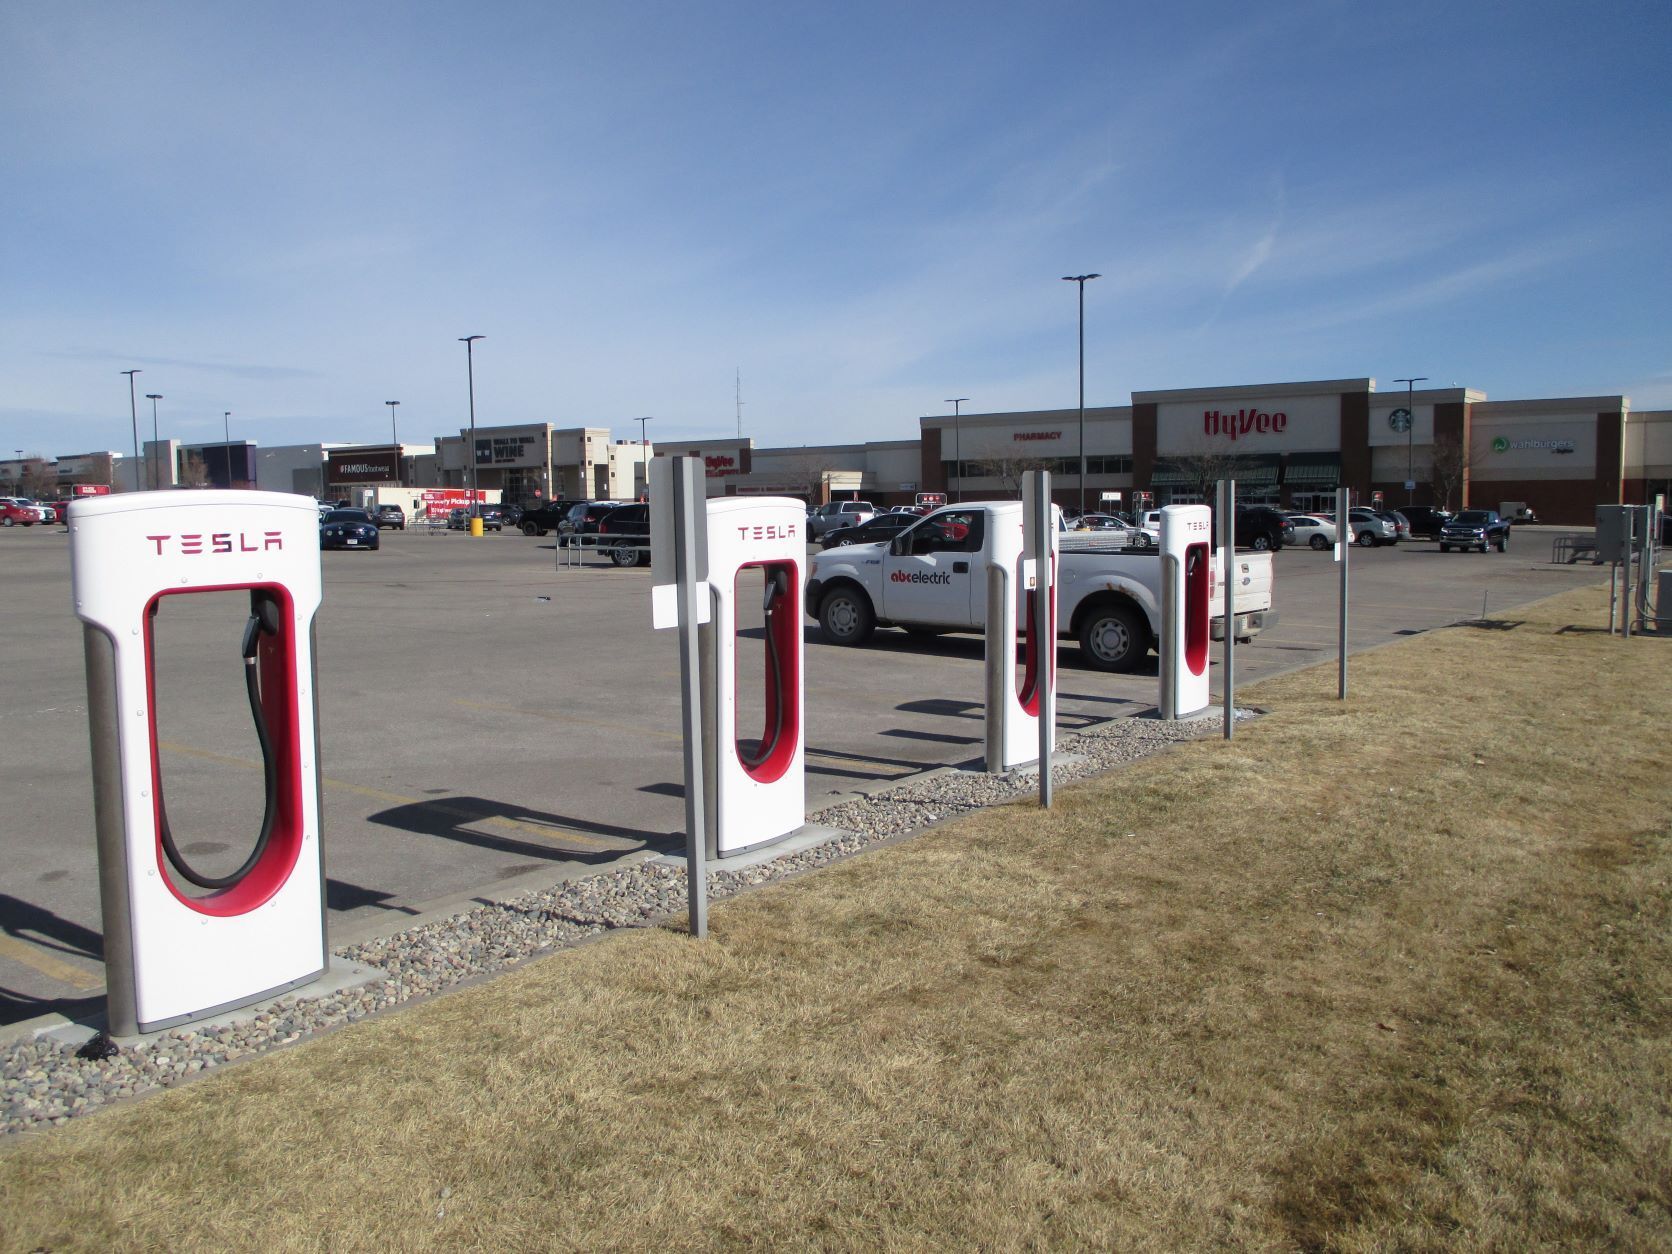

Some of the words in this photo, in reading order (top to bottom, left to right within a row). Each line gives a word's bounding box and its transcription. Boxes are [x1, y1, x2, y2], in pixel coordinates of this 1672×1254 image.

[1013, 431, 1062, 441] PHARMACY
[1509, 439, 1573, 450] wahlburgers
[493, 445, 524, 458] WINE
[450, 498, 470, 506] Pickup
[737, 524, 796, 541] TESLA
[146, 531, 282, 556] TESLA
